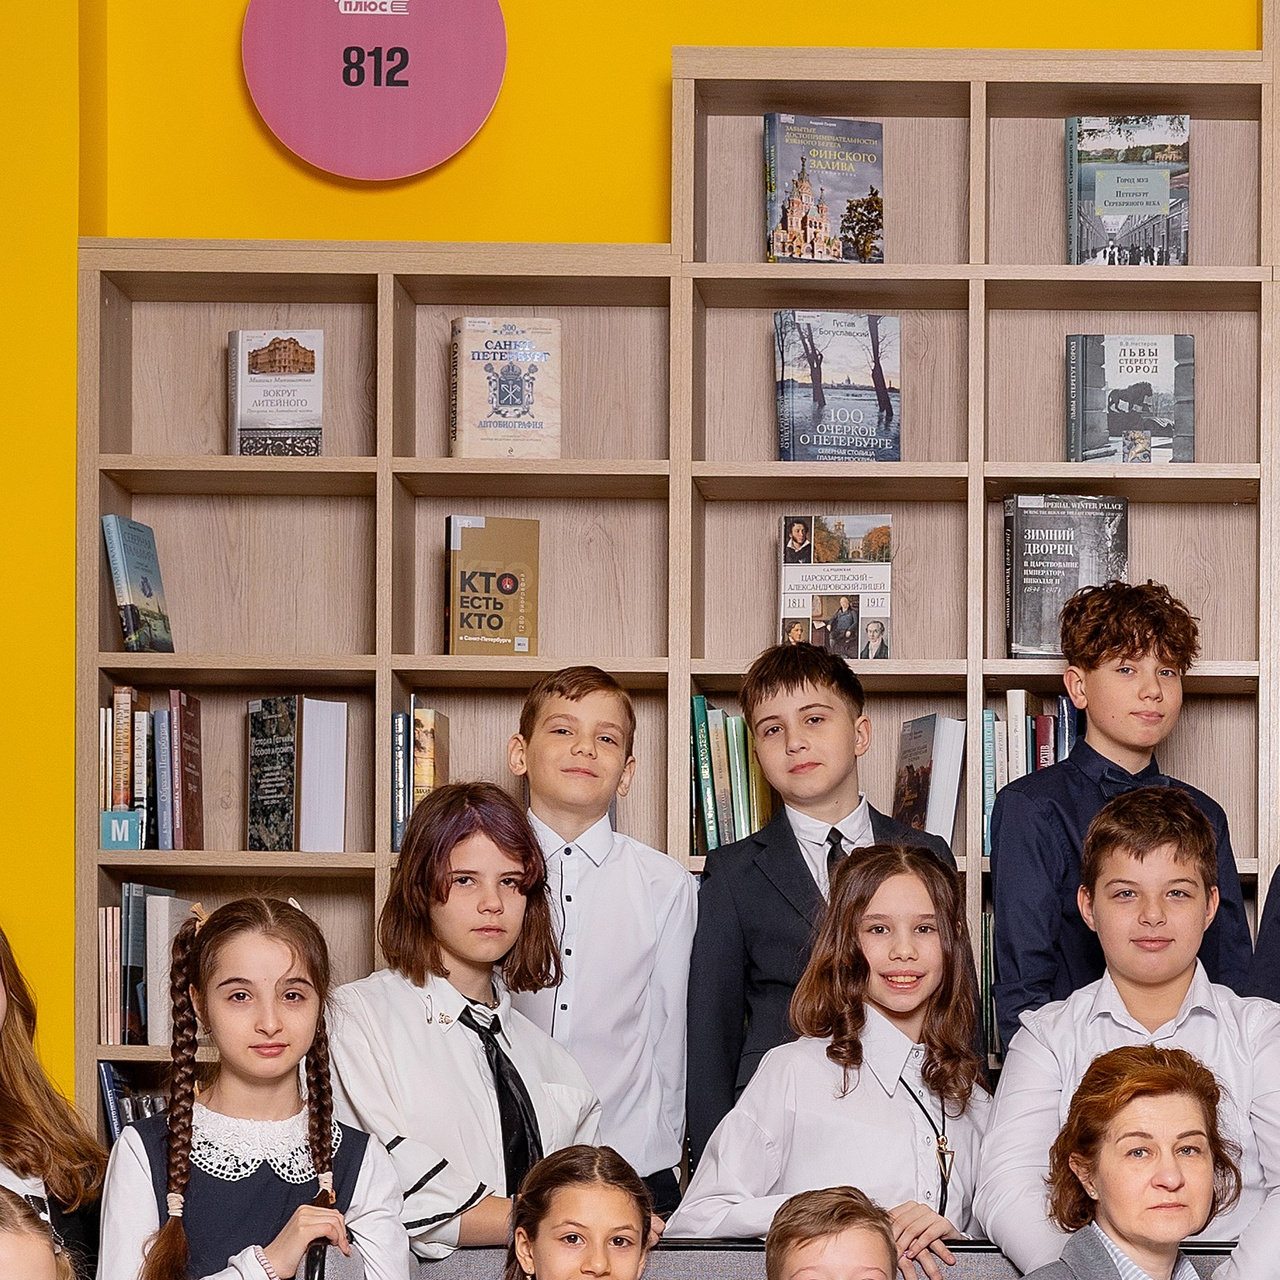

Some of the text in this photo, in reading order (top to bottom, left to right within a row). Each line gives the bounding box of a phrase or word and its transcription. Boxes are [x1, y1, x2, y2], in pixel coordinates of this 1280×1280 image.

[343, 1, 387, 12] ПЛЮС
[342, 46, 409, 87] 812
[809, 148, 877, 163] ФИНСКОГО
[809, 159, 856, 172] ЗАЛИВА
[832, 319, 856, 329] Густав
[818, 328, 869, 338] Богуславский
[484, 340, 536, 350] САНКТ-
[471, 350, 551, 362] ПЕТЕРБУРГ
[1119, 348, 1159, 357] ЛЬВЫ
[1119, 365, 1159, 374] ГОРОД
[263, 389, 297, 397] ВОКРУГ
[450, 342, 458, 442] САНКТ-ПЕТЕРБУРГ
[252, 398, 308, 407] ЛИТЕЙНОГО
[829, 407, 864, 423] 100
[477, 420, 544, 429] АВТОБИОГРАФИЯ
[816, 424, 877, 437] ОЧЕРКОВ
[799, 434, 893, 449] О ПЕТЕРБУРГЕ
[1044, 501, 1070, 509] PERIAL
[1098, 502, 1123, 510] PALACE
[1023, 527, 1075, 541] ЗИМНИЙ
[1023, 543, 1074, 557] ДВОРЕЦ
[1030, 561, 1079, 569] ЦАРСТВОВАНИЕ
[460, 570, 519, 595] КТО
[801, 573, 868, 582] ЦАРСКОСЕЛЬСКИЙ
[787, 582, 886, 591] АЛЕКСАНДРОВСКИЙ ЛИЦЕЙ
[460, 596, 504, 610] ЕСТЬ
[787, 597, 885, 608] 1811 1917
[460, 612, 504, 631] КТО
[464, 635, 512, 644] Санкт-Петербурге
[114, 700, 123, 791] ВОЕННЫЙ ПЕТЕРБУРГ
[159, 722, 168, 769] Петербурга
[160, 771, 168, 802] Образы
[111, 819, 130, 842] М
